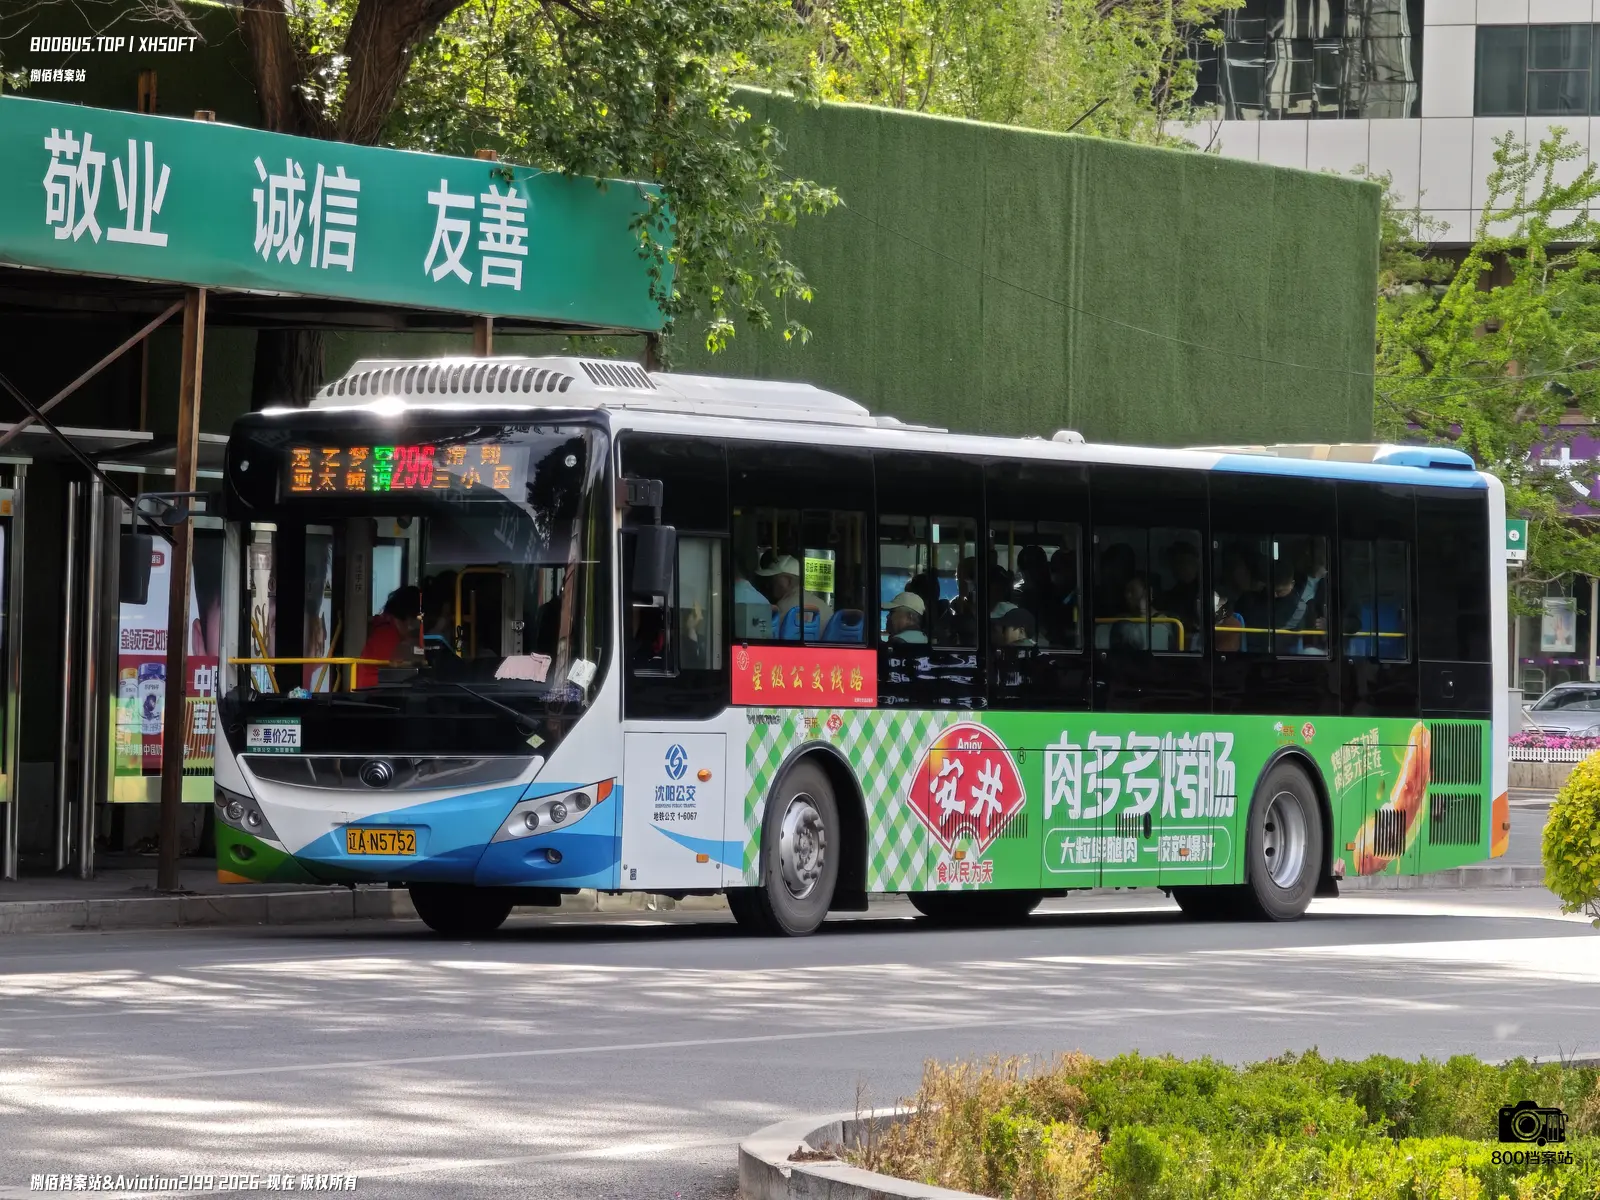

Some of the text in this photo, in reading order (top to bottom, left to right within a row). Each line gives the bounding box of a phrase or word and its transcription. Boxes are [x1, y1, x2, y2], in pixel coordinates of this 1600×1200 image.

[43, 128, 529, 291] 敬业 诚信 友善
[391, 446, 435, 489] 296
[433, 466, 512, 489] 三小区
[120, 629, 168, 651] 金领冠奶
[752, 662, 865, 694] 星级公交线路
[263, 728, 297, 744] 票价2元
[957, 734, 983, 754] Anjoy
[1044, 730, 1236, 820] 肉多多烤肠
[654, 785, 697, 802] 沈阳公交
[930, 757, 1004, 828] 安井
[653, 811, 697, 821] 地铁公交 1-6067
[937, 861, 994, 884] 食以民为天
